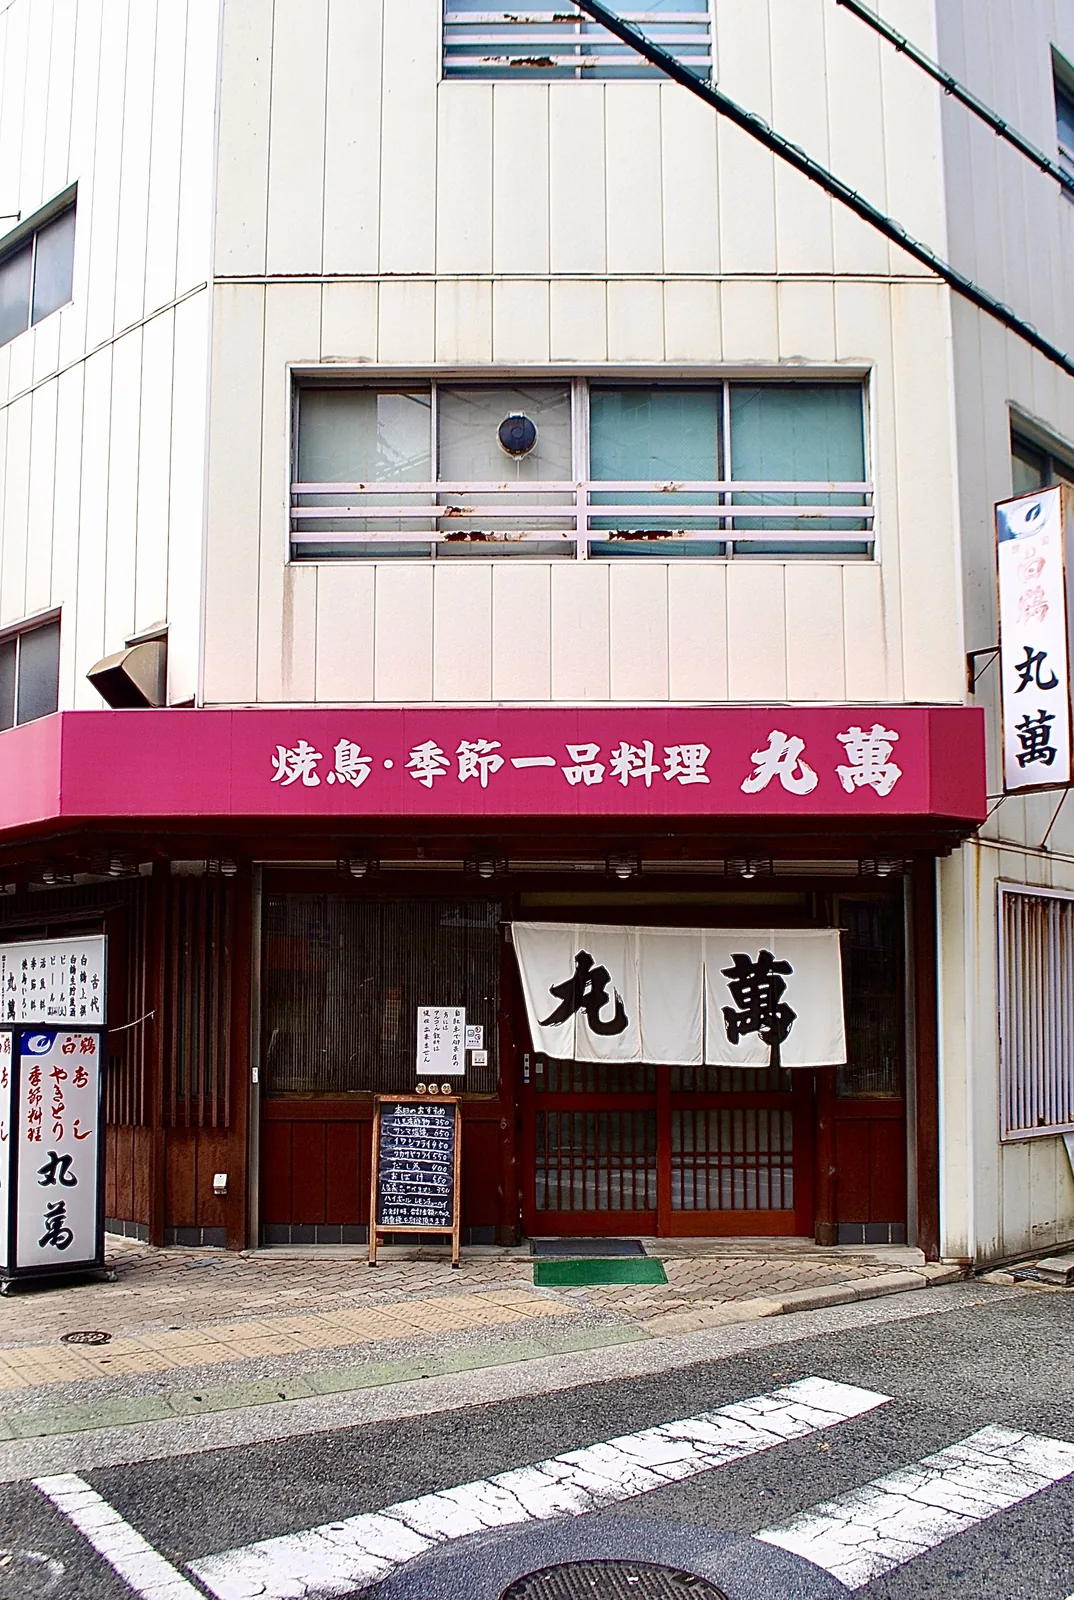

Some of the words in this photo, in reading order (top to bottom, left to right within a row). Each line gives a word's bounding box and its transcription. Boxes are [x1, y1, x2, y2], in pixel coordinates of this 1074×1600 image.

[1013, 645, 1058, 768] 丸萬
[269, 739, 712, 789] 焼鳥・季節一品料理
[740, 723, 904, 797] 丸萬
[6, 971, 17, 1021] 丸萬
[538, 949, 798, 1045] 丸萬
[62, 1035, 96, 1055] 白鶴
[27, 1065, 43, 1142] 季節料理
[48, 1065, 68, 1142] やきとり
[72, 1066, 93, 1140] 寿し
[394, 1104, 446, 1115] 本日のおすすめ
[433, 1128, 450, 1137] 650
[435, 1118, 450, 1126] 350
[37, 1150, 79, 1251] 丸萬
